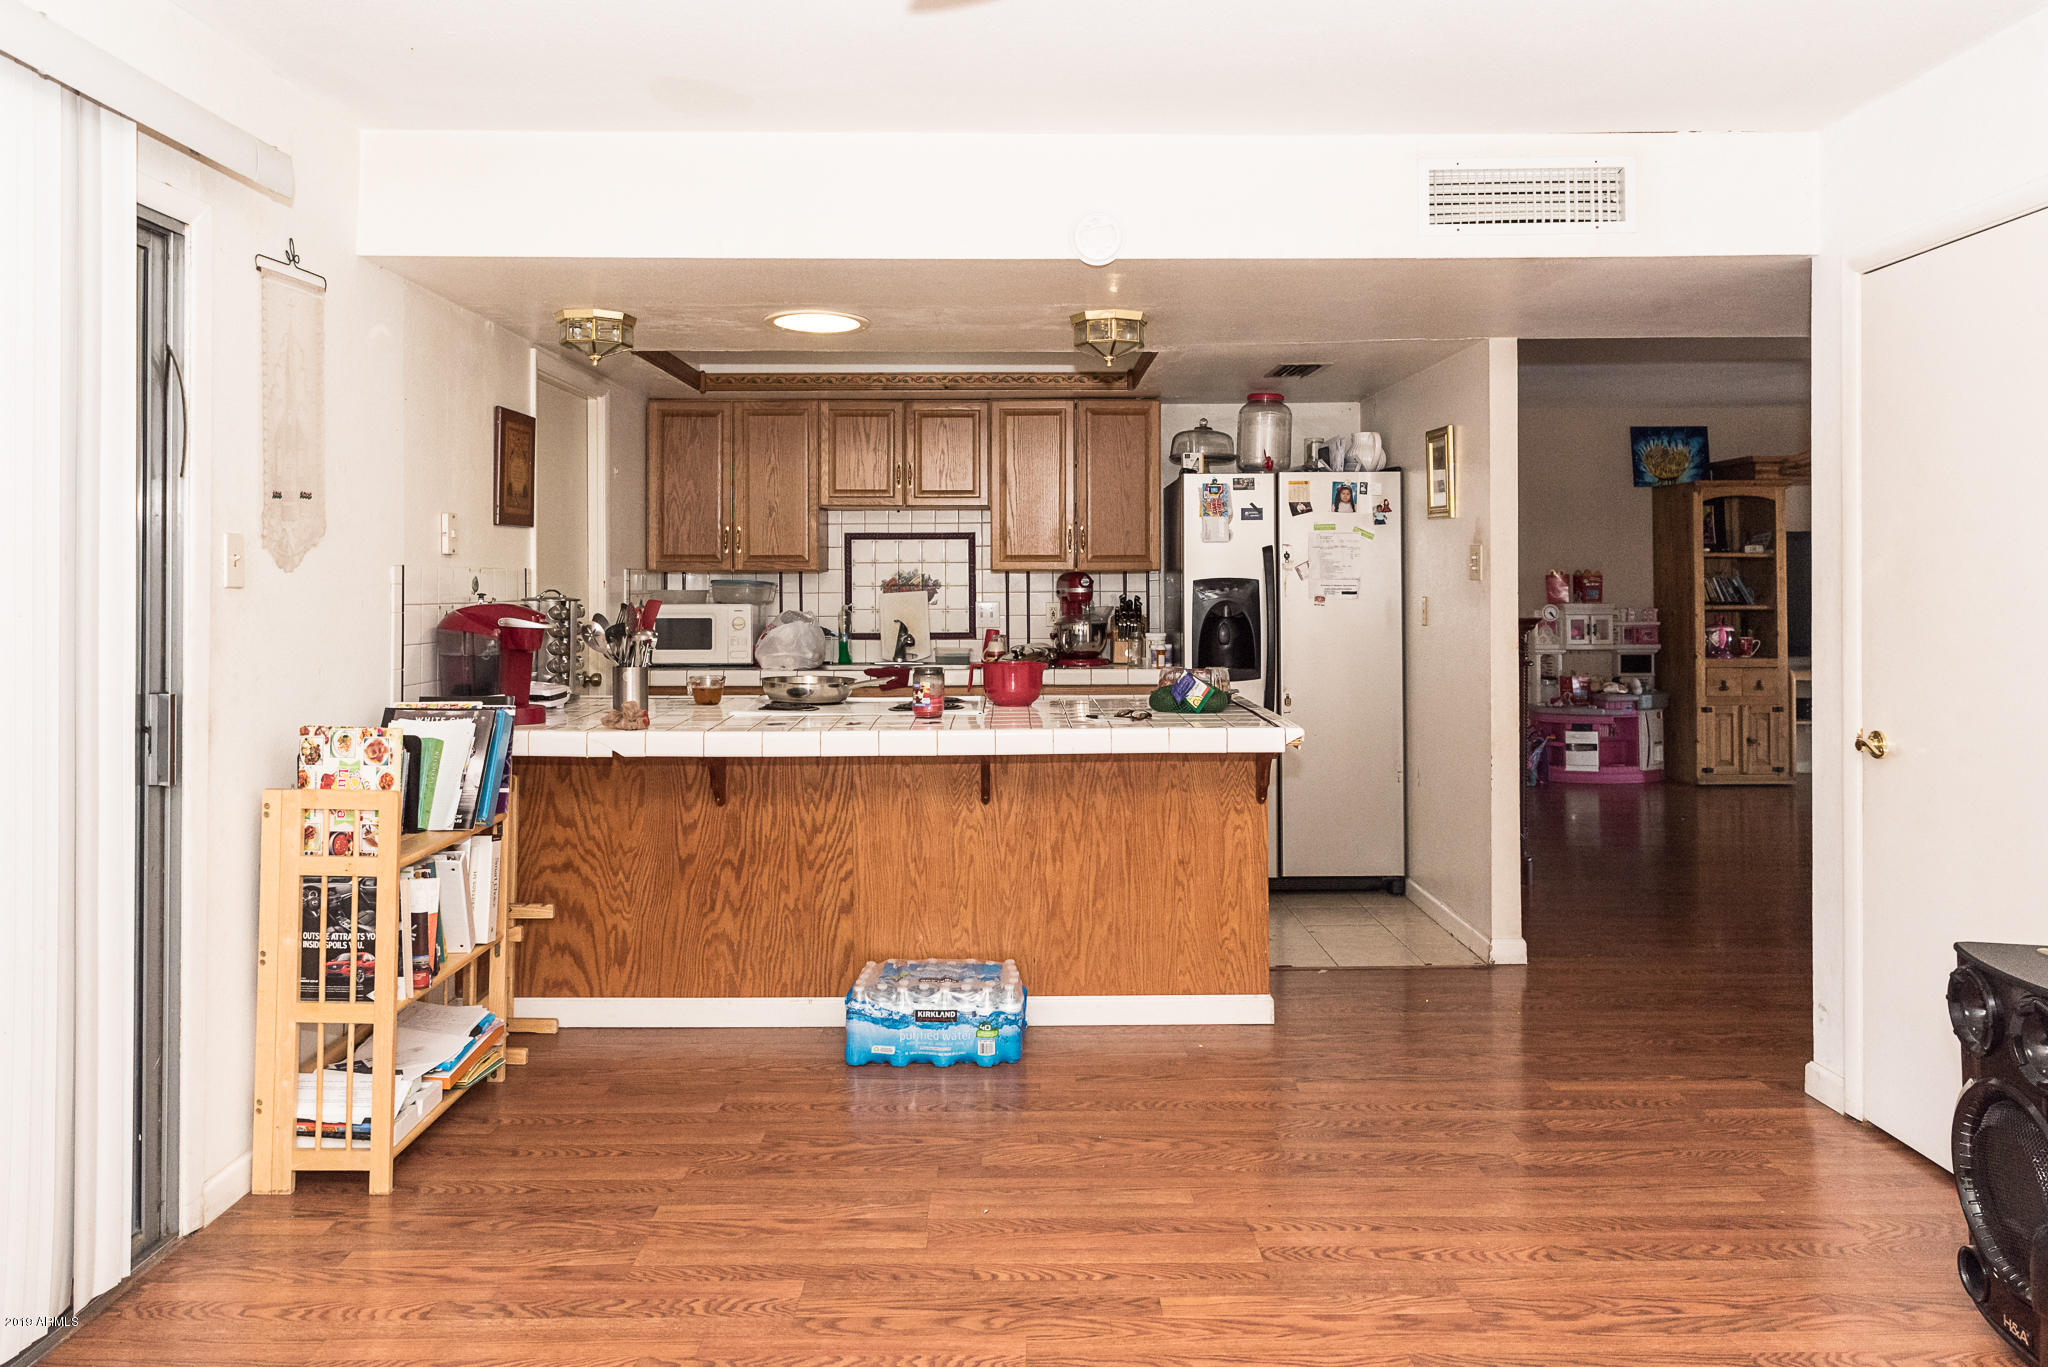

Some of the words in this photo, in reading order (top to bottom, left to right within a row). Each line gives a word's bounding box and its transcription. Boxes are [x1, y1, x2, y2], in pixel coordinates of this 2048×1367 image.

[303, 932, 329, 940] OUTSE
[331, 932, 365, 940] ATTRATS
[917, 1010, 956, 1018] KIRKLAND
